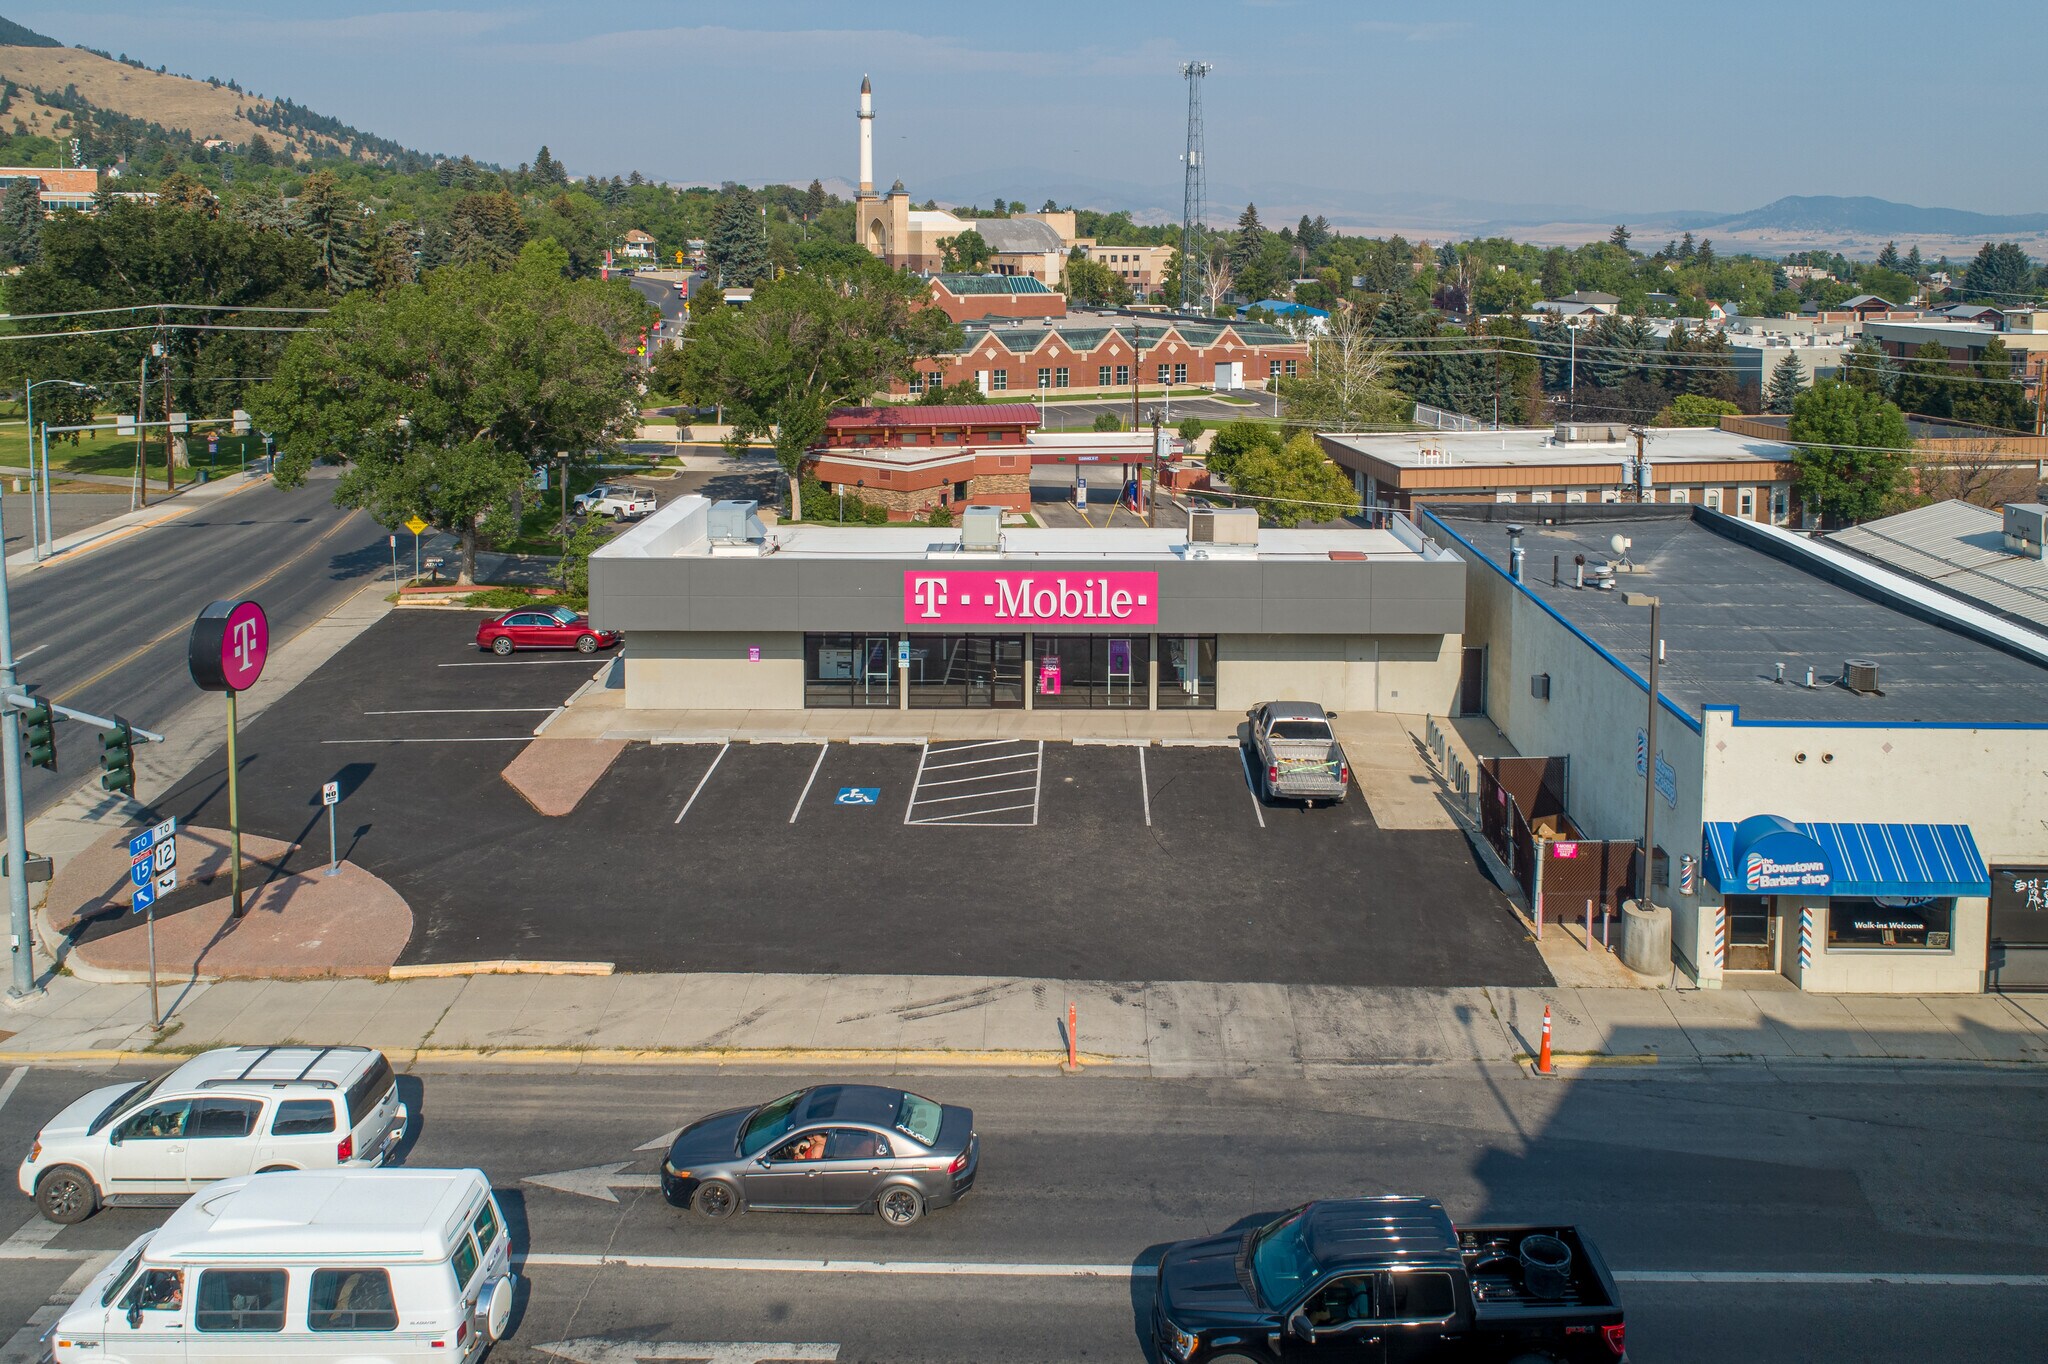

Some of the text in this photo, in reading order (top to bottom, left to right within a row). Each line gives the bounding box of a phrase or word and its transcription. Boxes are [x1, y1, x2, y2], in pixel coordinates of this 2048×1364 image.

[233, 617, 257, 672] T
[325, 790, 337, 798] NO
[159, 823, 170, 836] TO
[135, 836, 147, 850] TO
[158, 844, 172, 866] 12
[136, 860, 149, 880] 15
[1762, 861, 1824, 875] Downtown
[1760, 873, 1830, 888] Barber shop
[1854, 921, 1888, 929] Walk-ins
